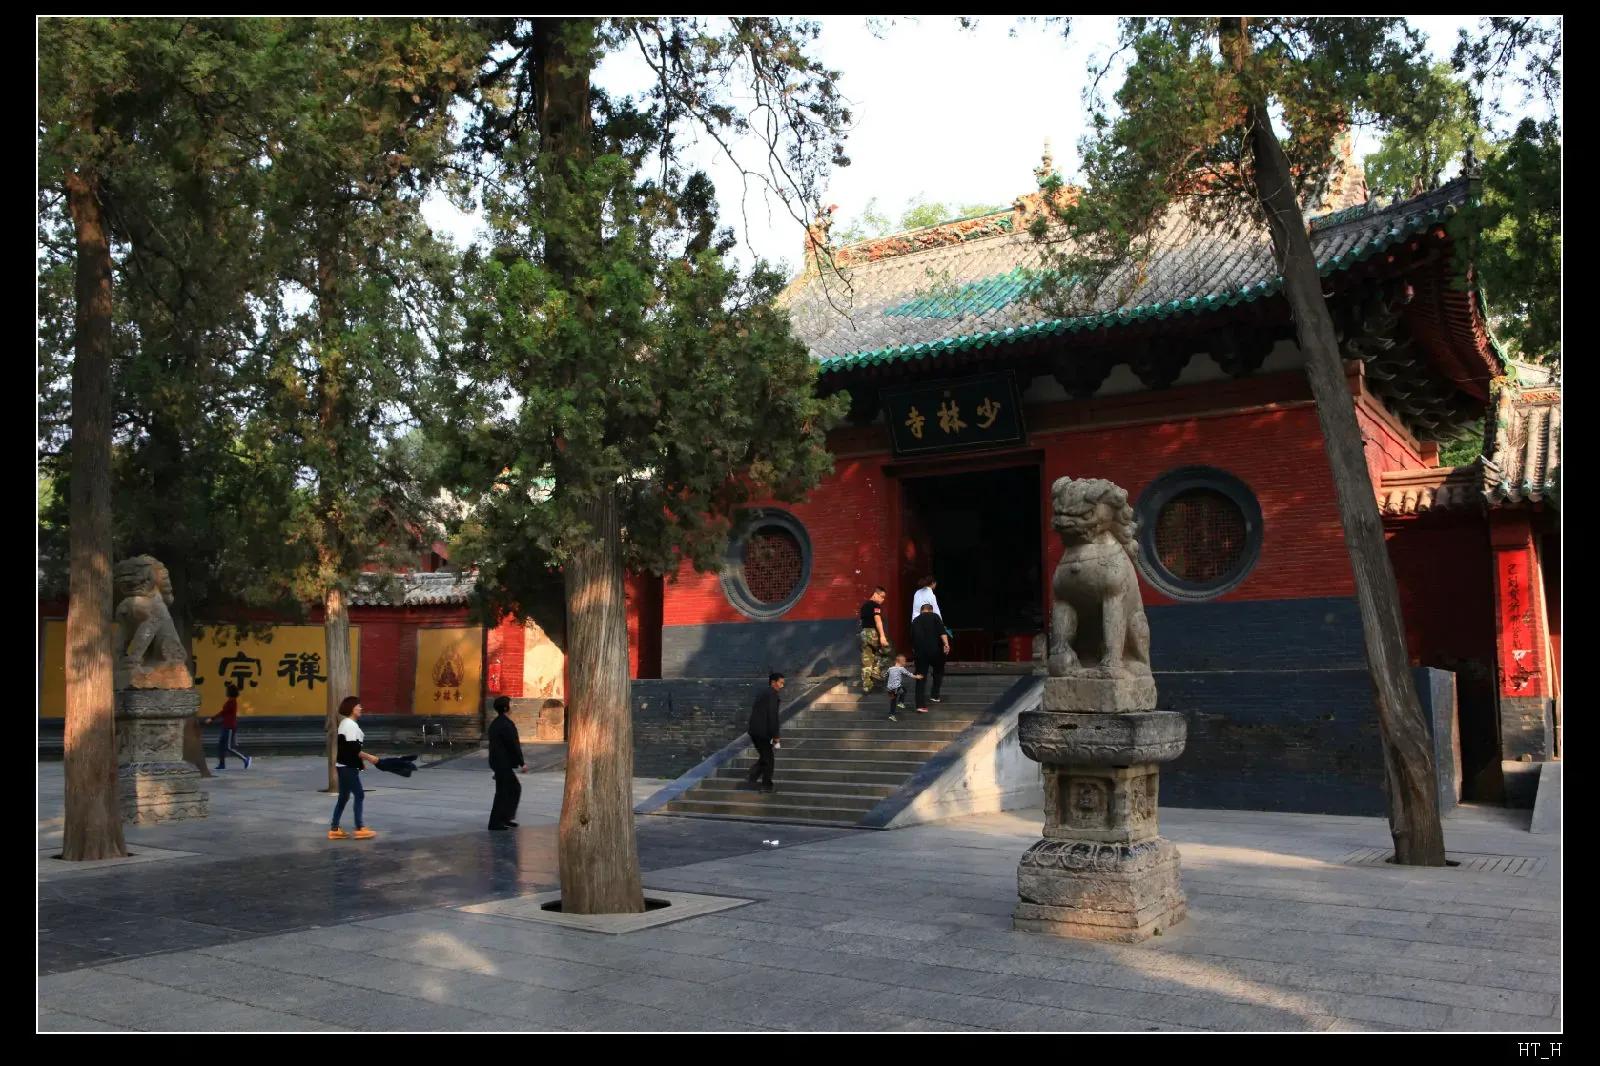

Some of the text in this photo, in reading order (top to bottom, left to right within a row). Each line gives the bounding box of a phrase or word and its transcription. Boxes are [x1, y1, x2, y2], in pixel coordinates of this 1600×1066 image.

[904, 397, 1000, 439] 少林寺
[191, 651, 328, 690] 禪宗
